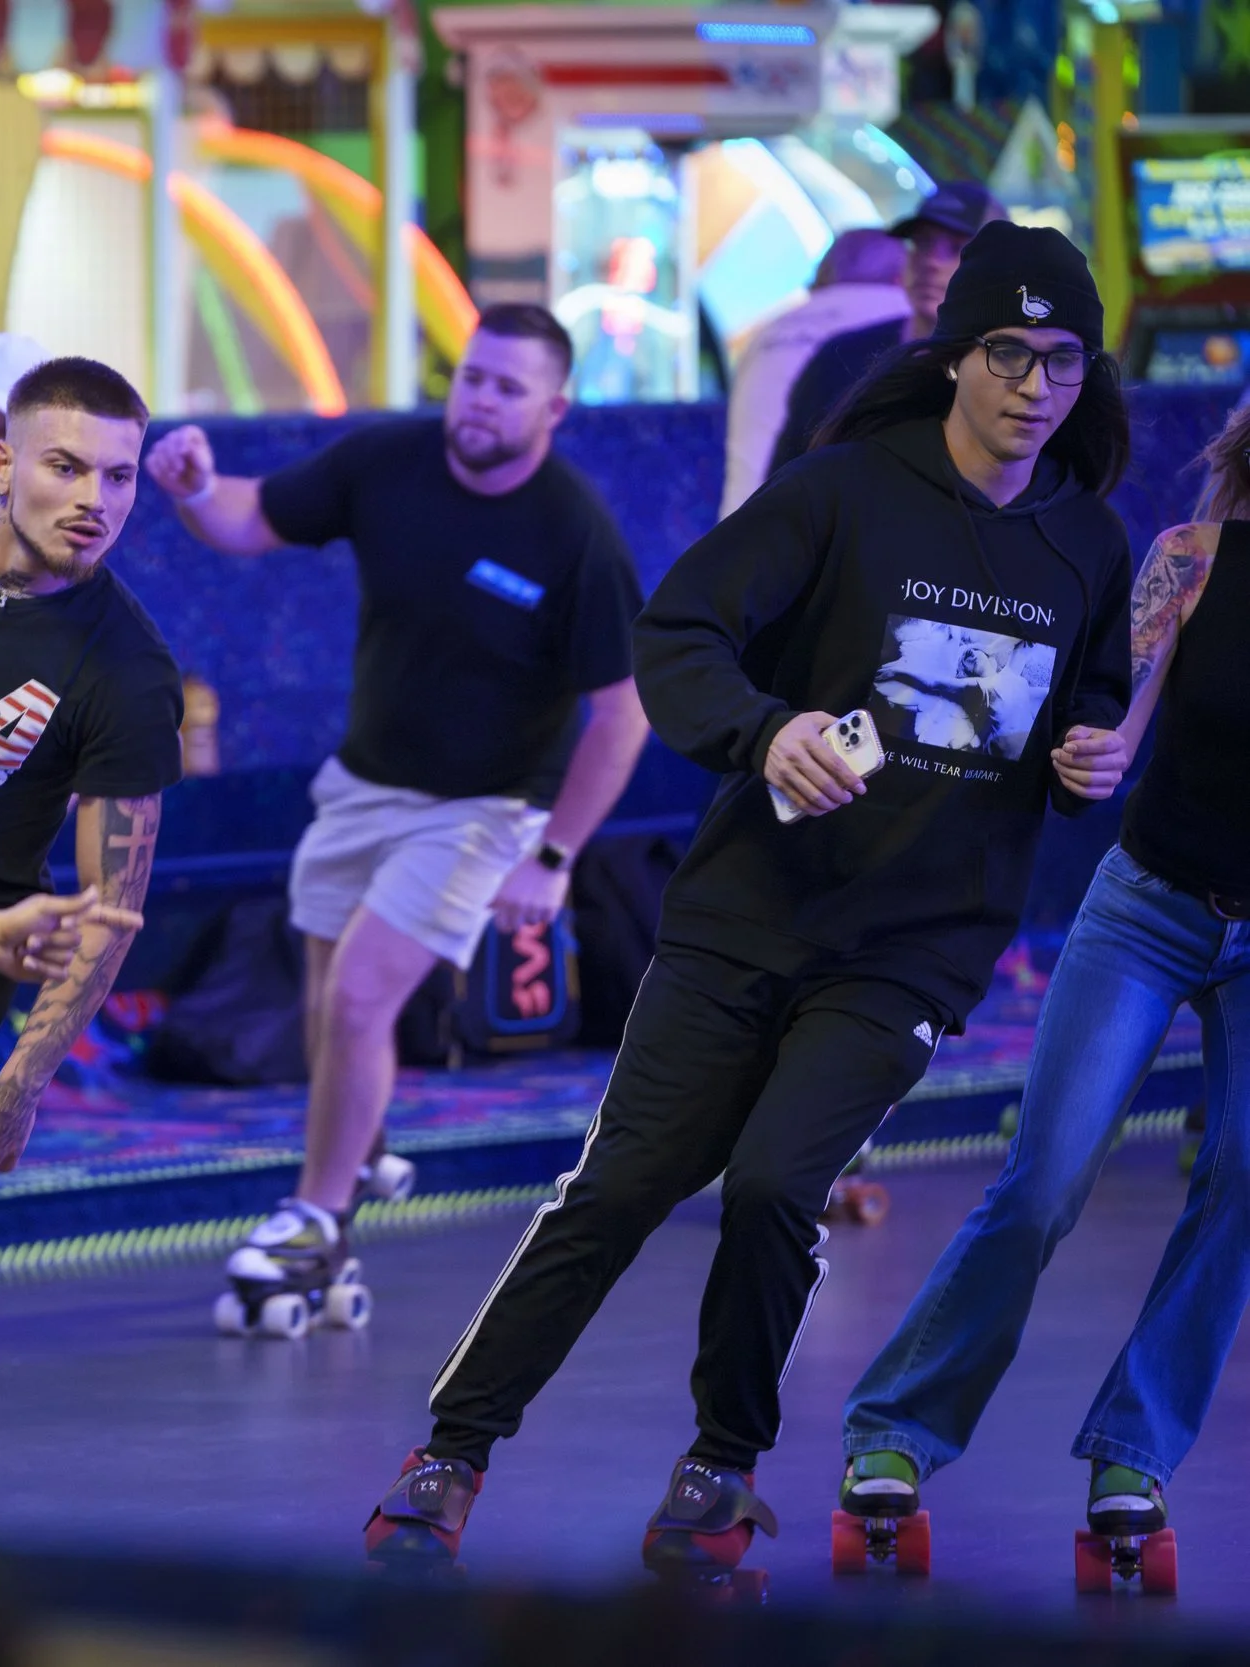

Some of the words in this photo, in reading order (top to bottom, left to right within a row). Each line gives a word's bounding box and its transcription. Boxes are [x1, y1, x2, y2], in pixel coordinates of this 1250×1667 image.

[902, 578, 946, 605] JOY
[951, 587, 1053, 627] DIVISION
[900, 754, 929, 771] WILL
[933, 761, 961, 778] TEAR
